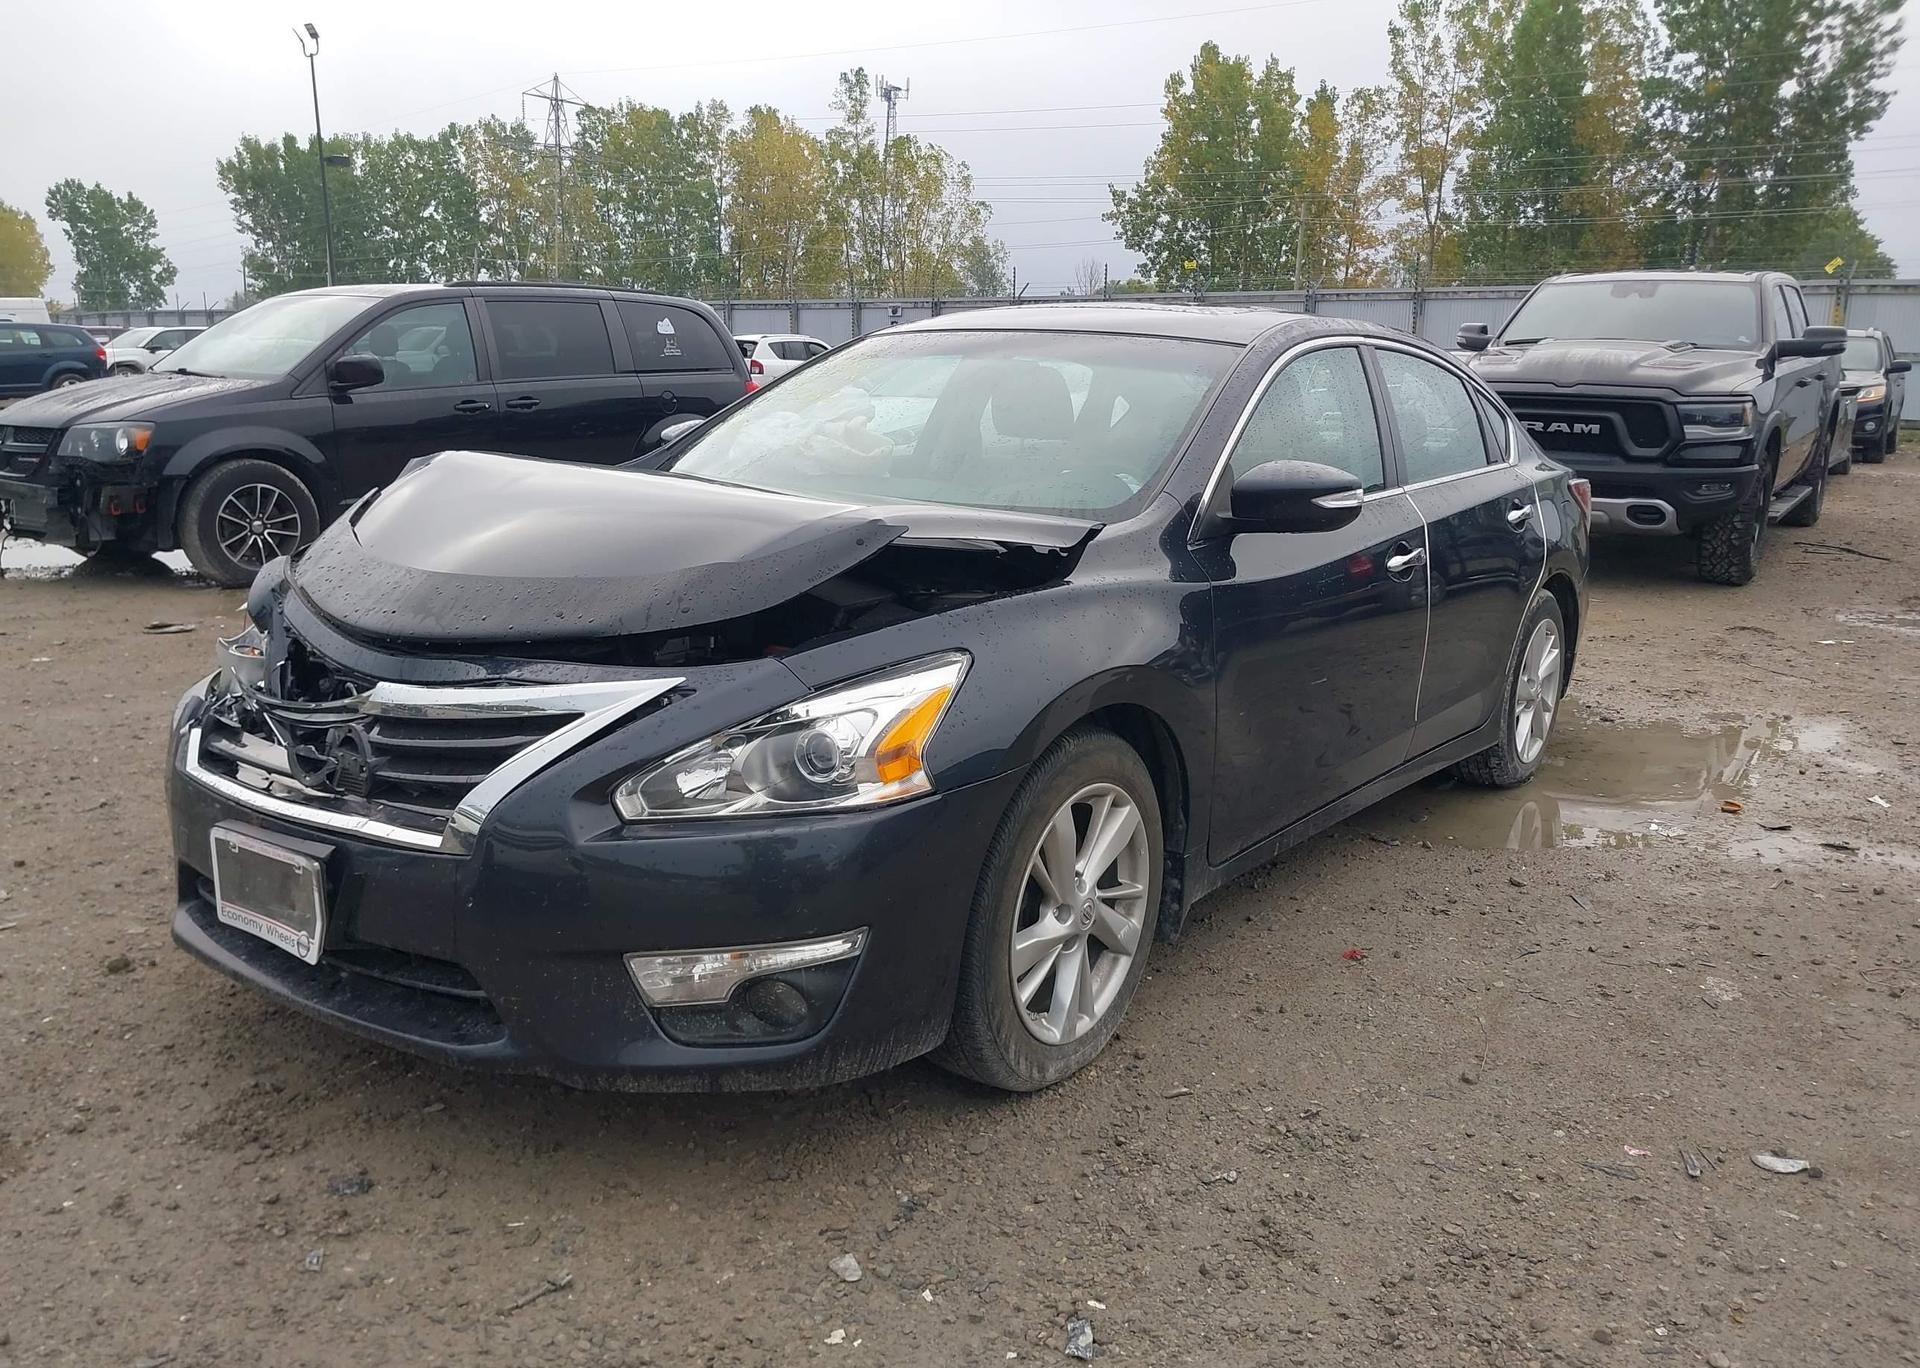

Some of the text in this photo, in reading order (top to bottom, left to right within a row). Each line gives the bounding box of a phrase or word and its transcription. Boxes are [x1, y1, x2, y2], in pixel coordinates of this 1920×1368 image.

[1519, 420, 1600, 435] RAM
[221, 906, 296, 948] Economy Wheels
